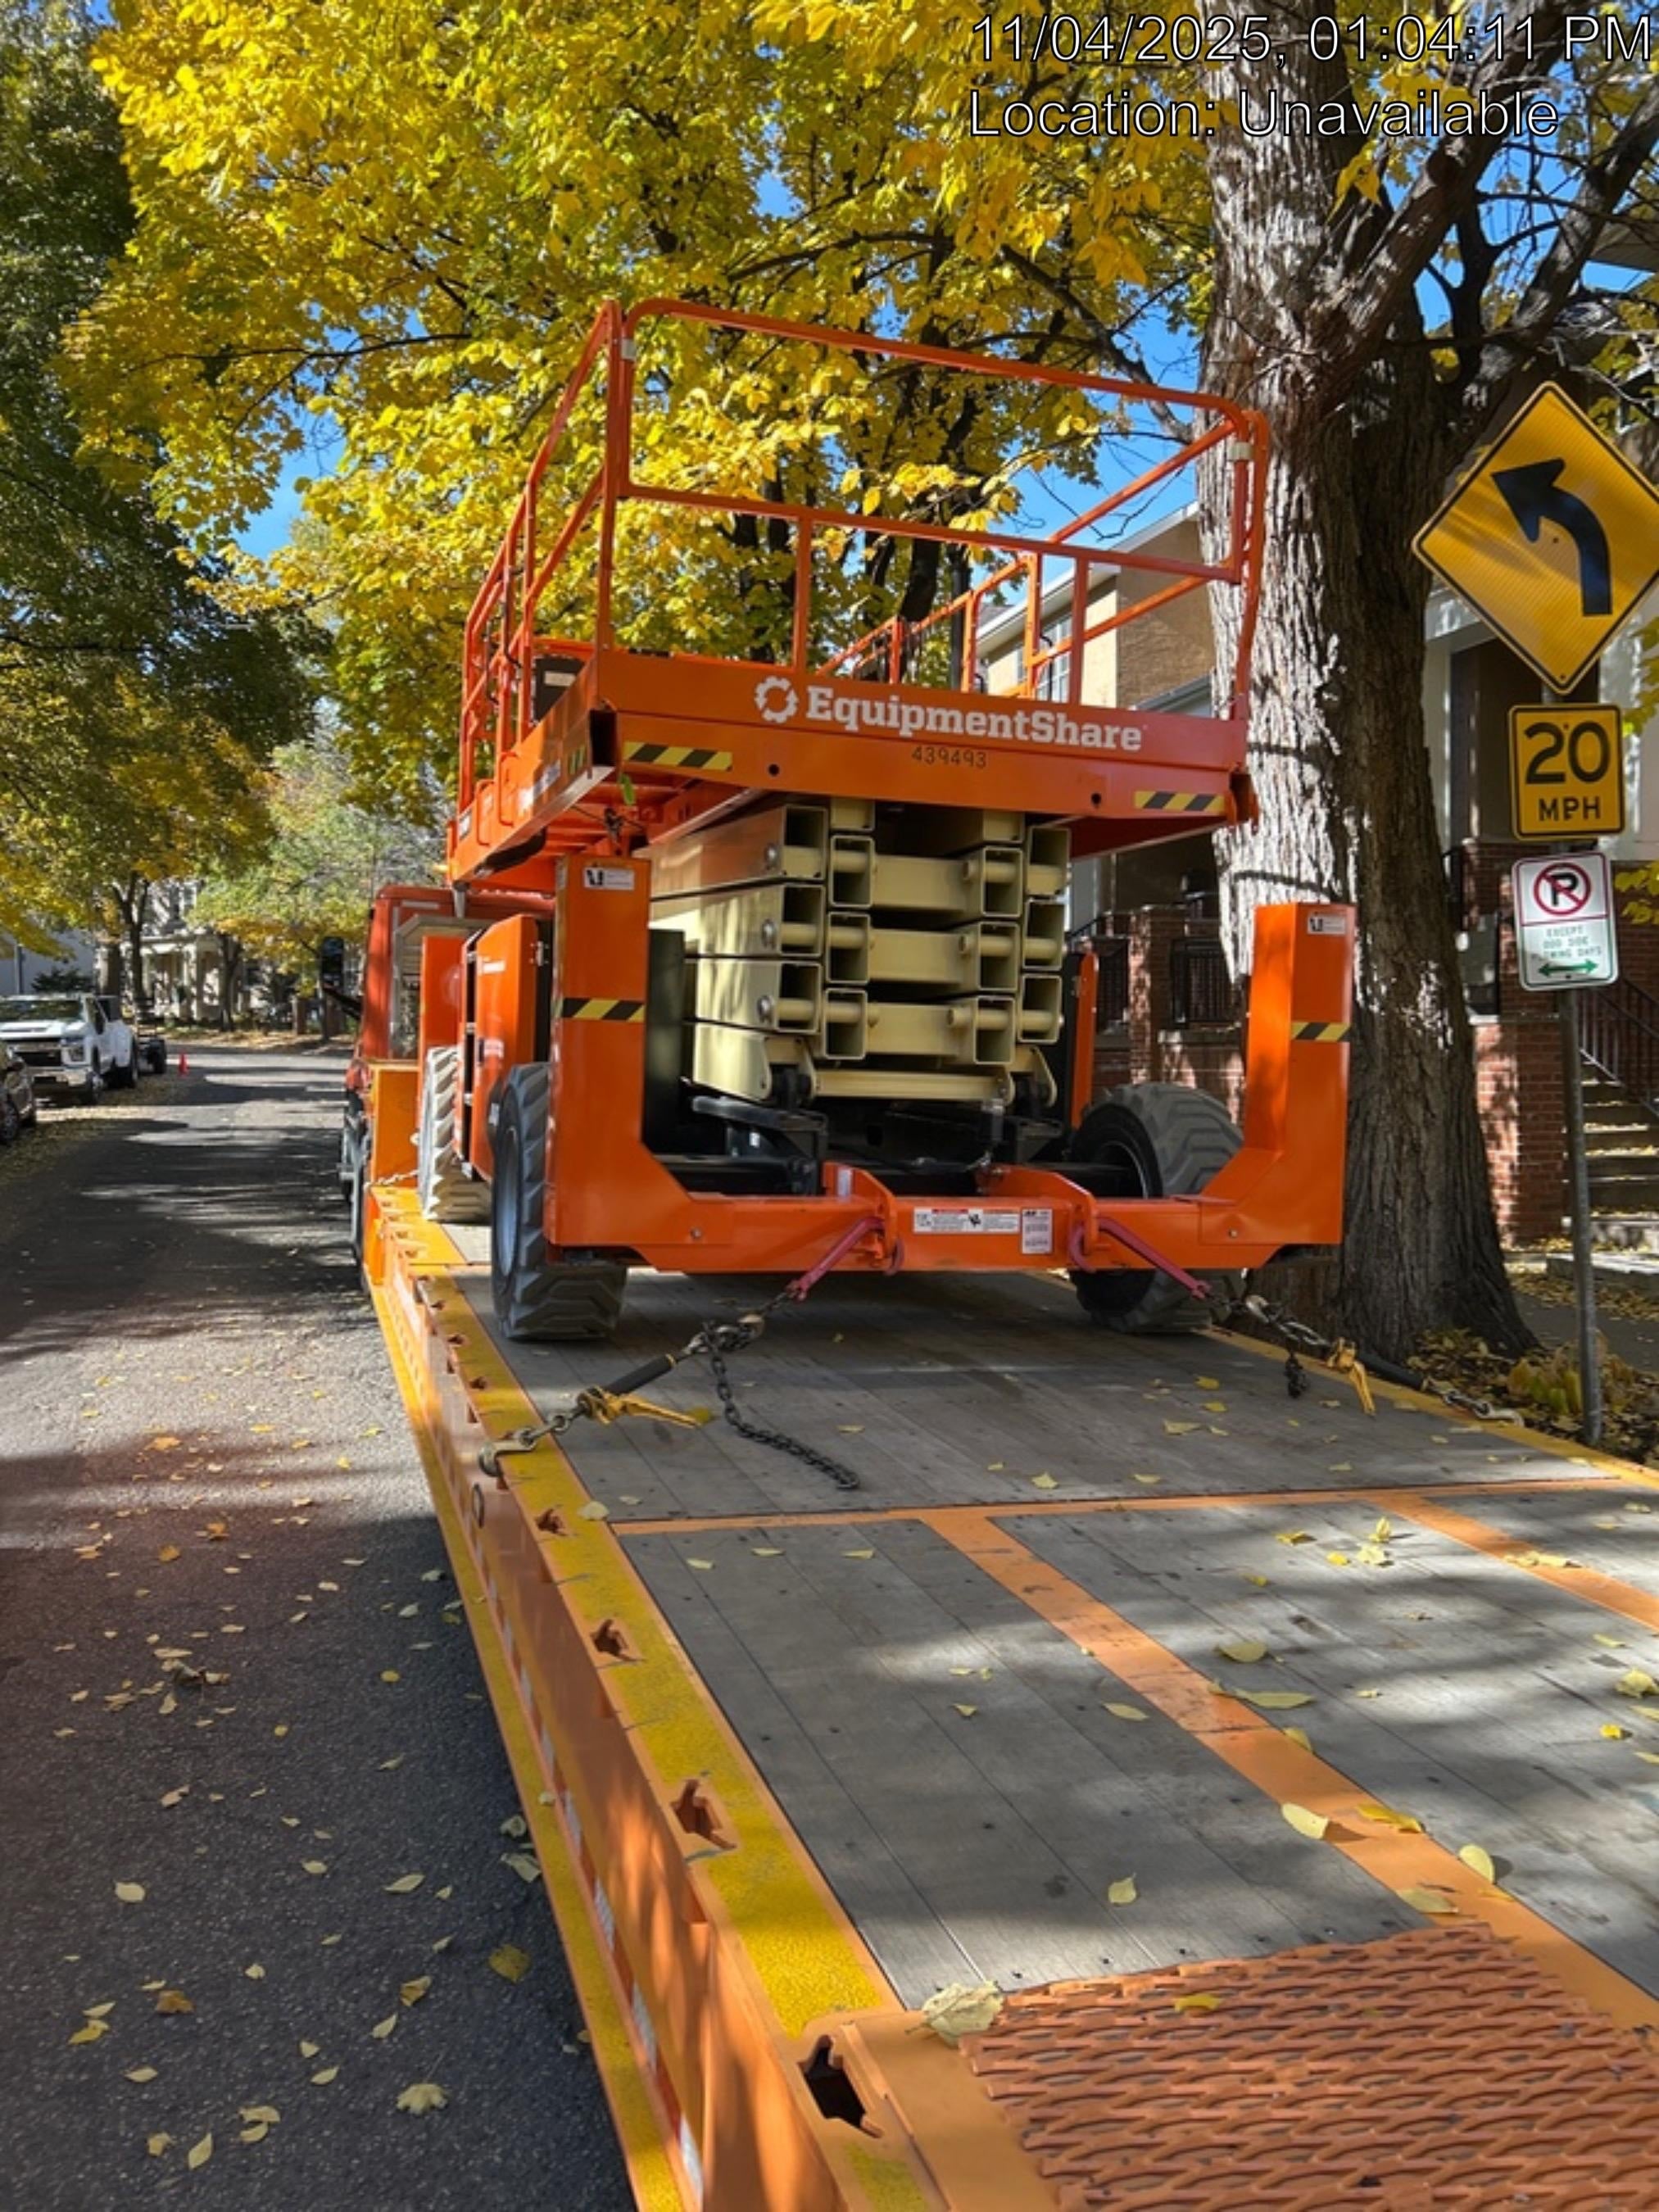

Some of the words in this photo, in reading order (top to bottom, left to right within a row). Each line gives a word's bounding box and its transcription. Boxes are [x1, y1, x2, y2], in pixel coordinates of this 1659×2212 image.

[806, 685, 1142, 751] EquipmentShare
[911, 746, 987, 768] 439493
[1523, 721, 1611, 785] 20
[1538, 796, 1601, 822] MPH
